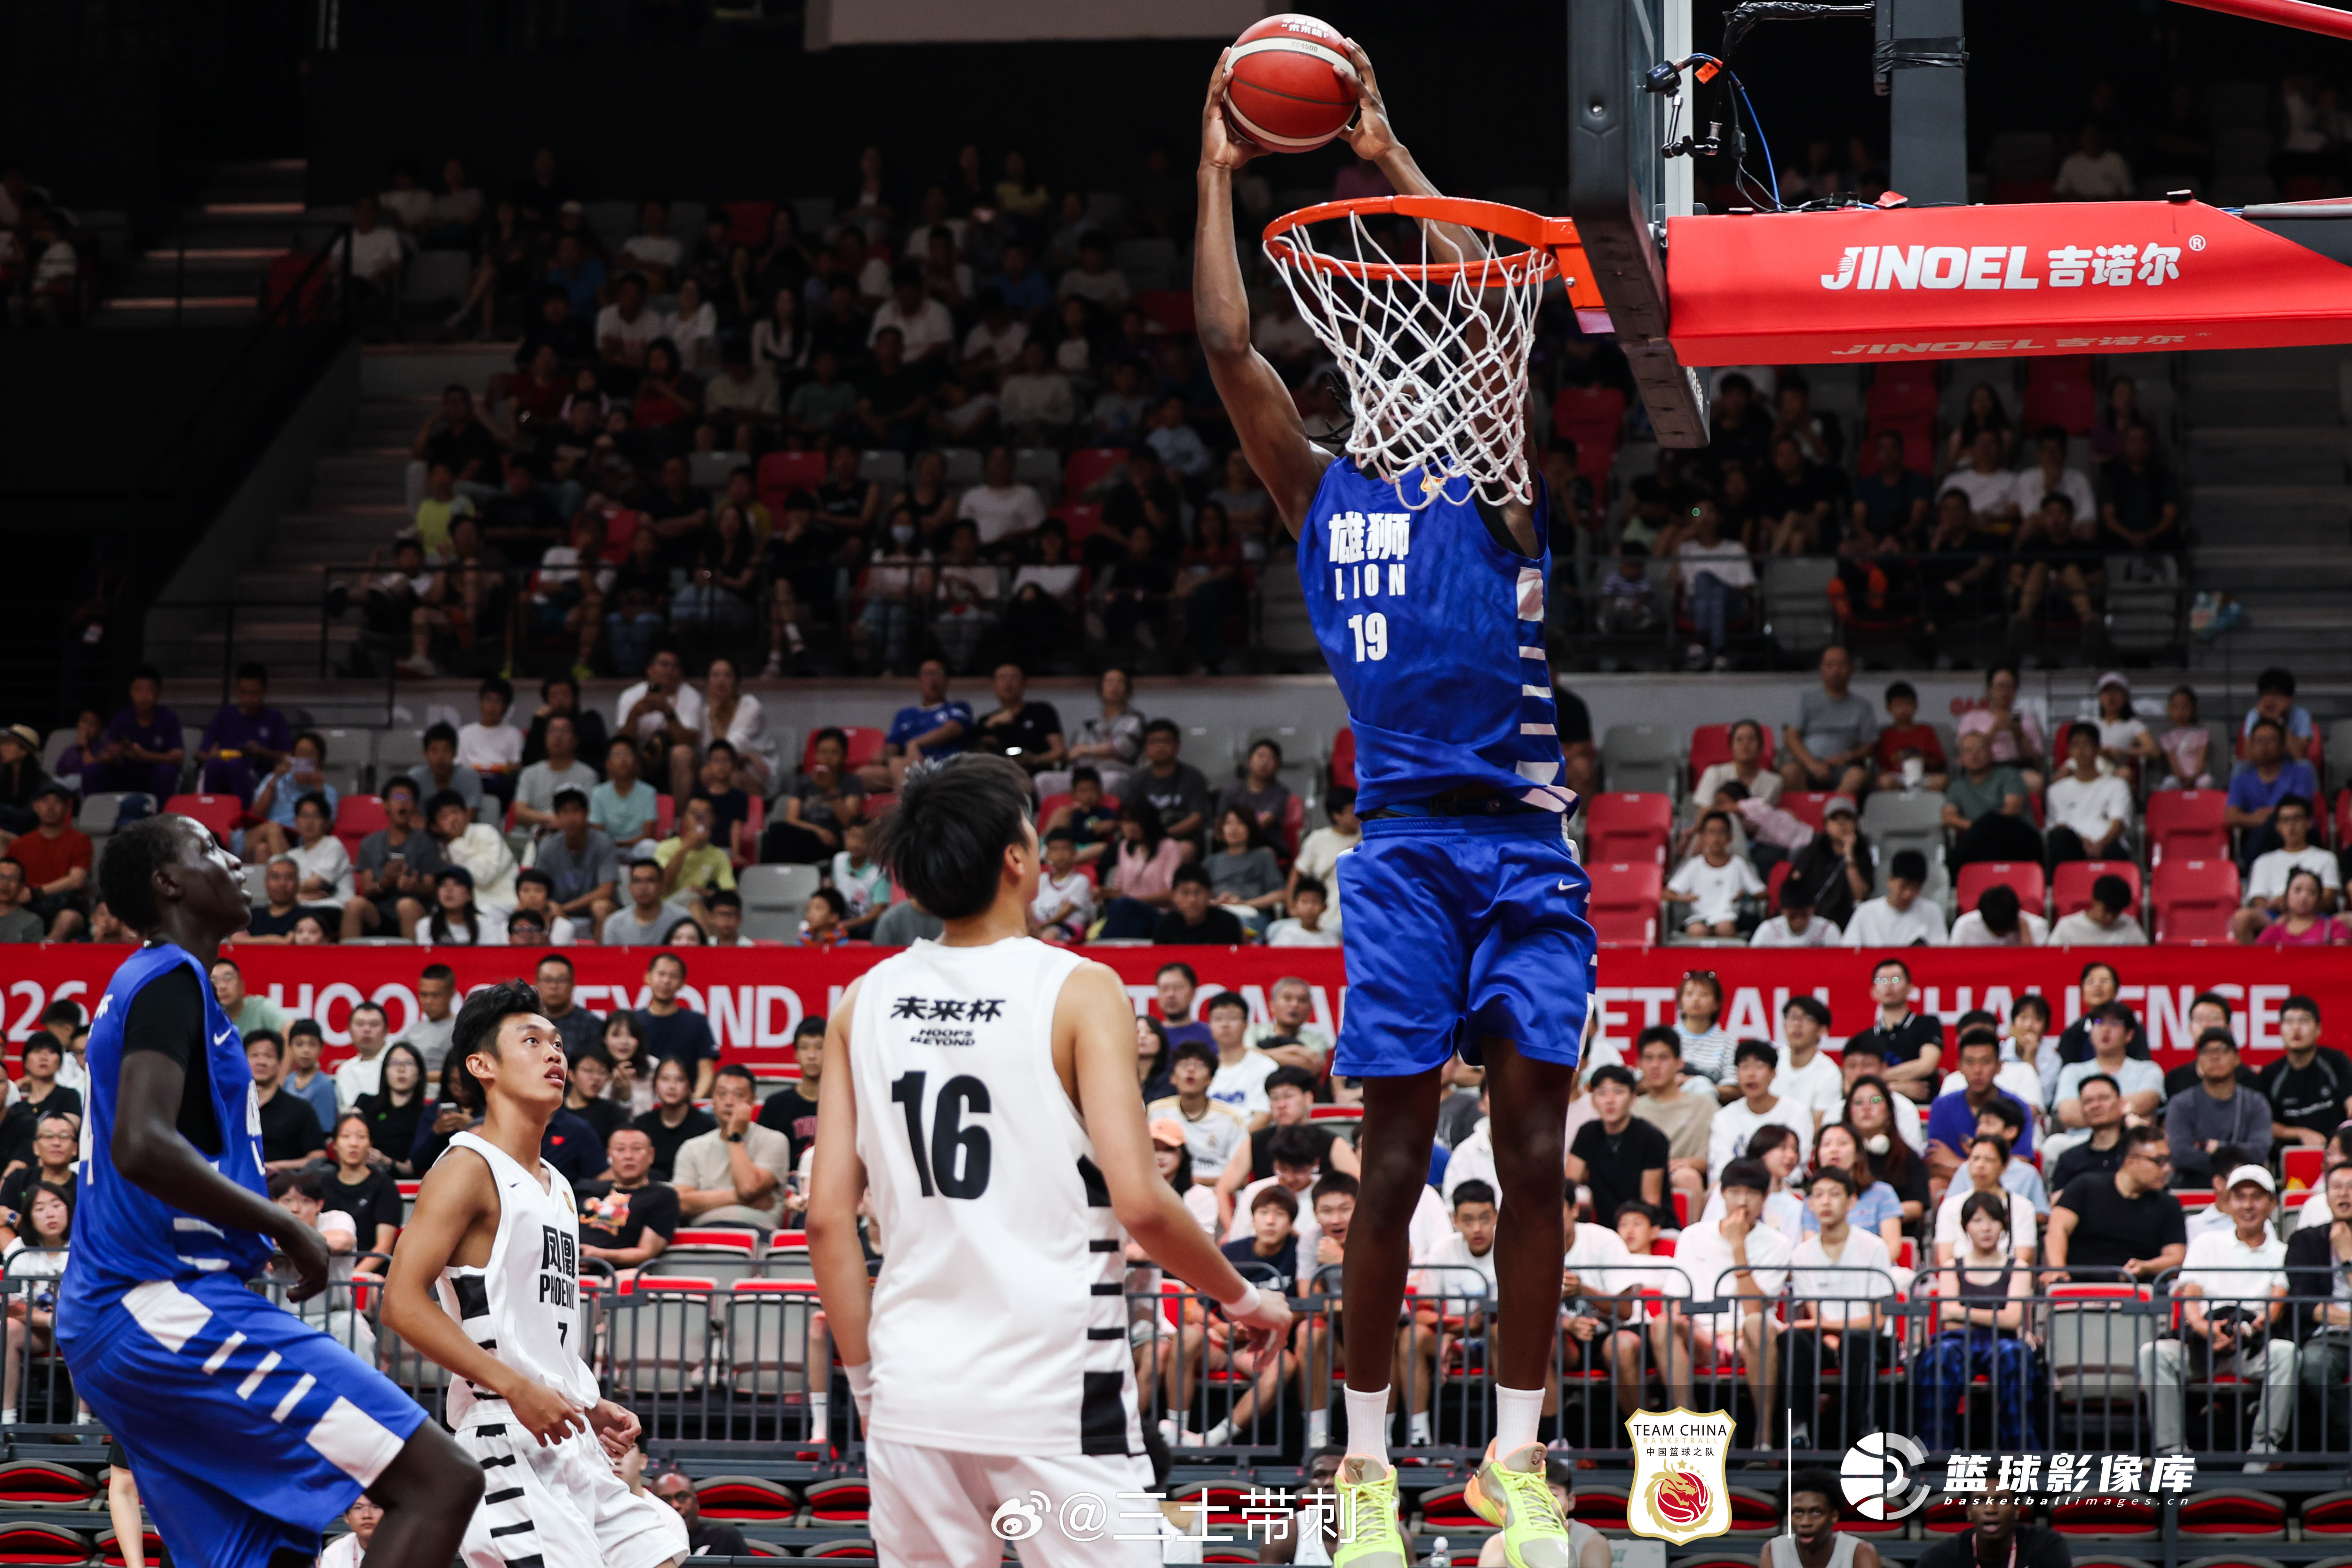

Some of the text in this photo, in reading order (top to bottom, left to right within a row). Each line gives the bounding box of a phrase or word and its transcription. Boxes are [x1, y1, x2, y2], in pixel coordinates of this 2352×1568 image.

[1821, 246, 2039, 290] JINOEL
[2048, 242, 2182, 287] 吉诺尔
[1831, 335, 2187, 355] JINOEL 吉诺尔
[1329, 511, 1410, 564] 雄狮
[1335, 564, 1406, 601] LION
[1348, 612, 1388, 662] 19
[0, 979, 90, 1042] 26
[890, 996, 1007, 1022] 未来杯
[909, 1036, 975, 1046] BEYOND
[892, 1071, 991, 1200] 16
[541, 1224, 576, 1279] 凤凰
[558, 1321, 568, 1350] 7
